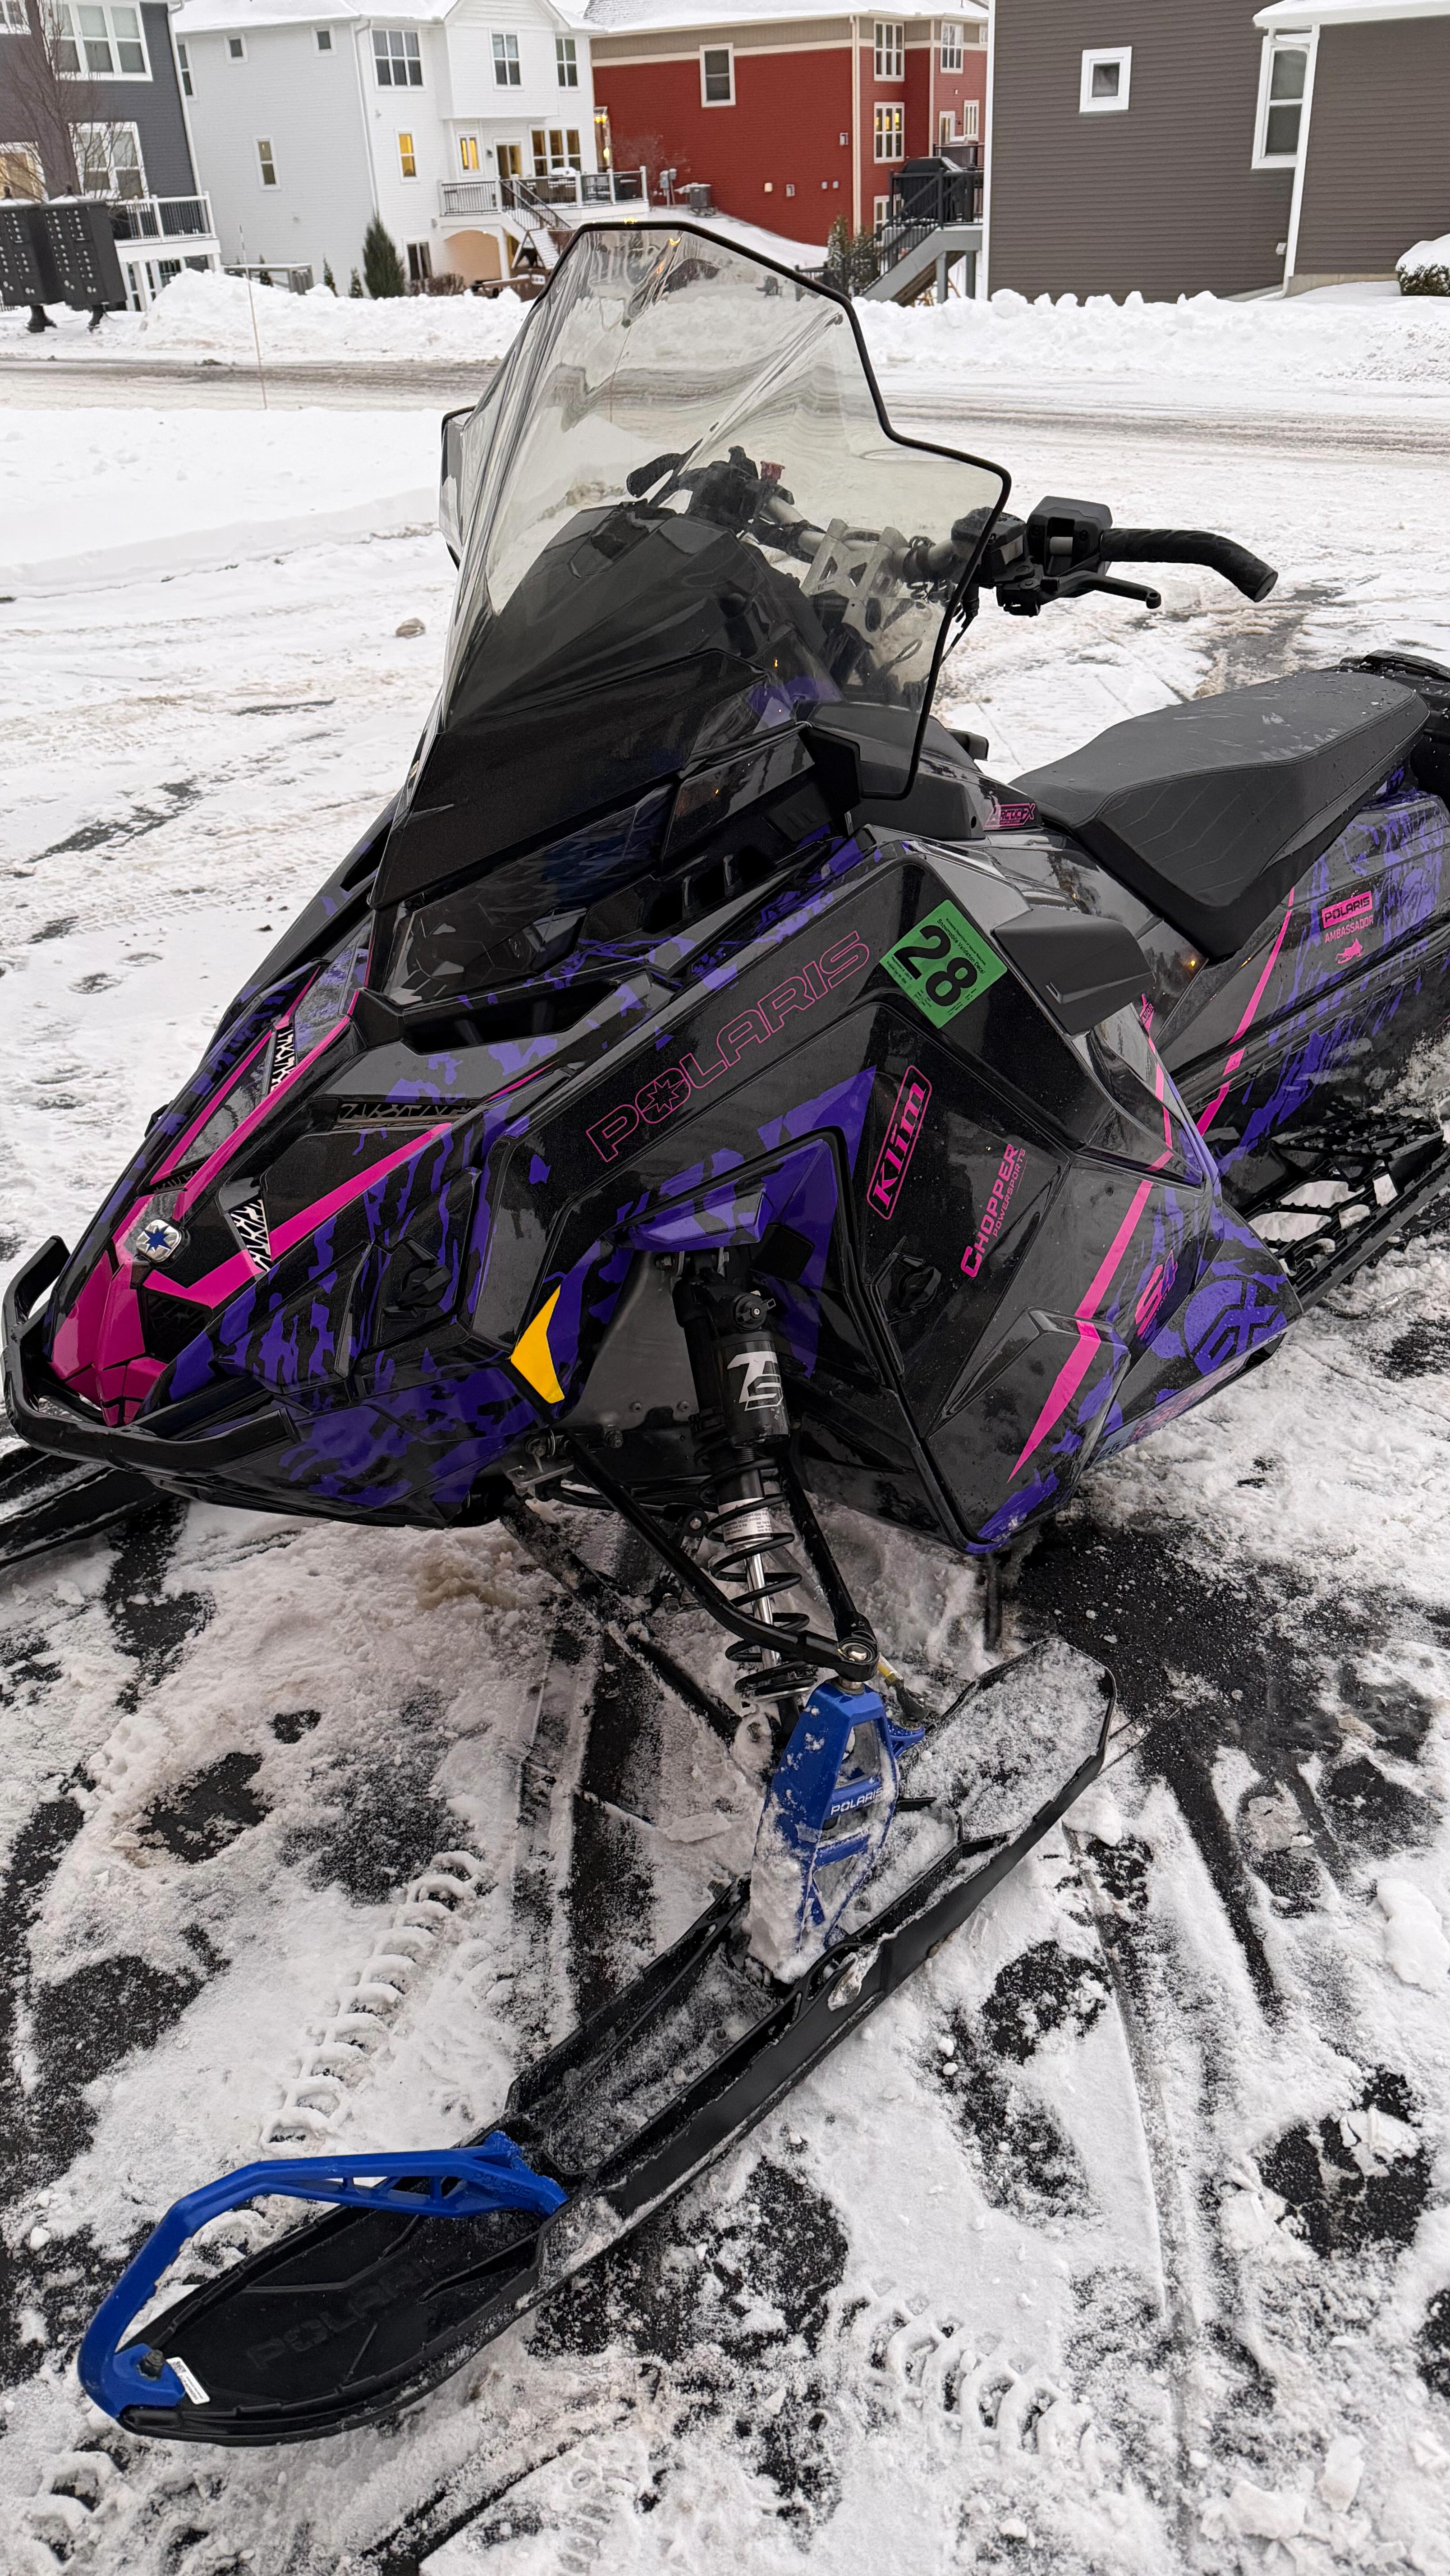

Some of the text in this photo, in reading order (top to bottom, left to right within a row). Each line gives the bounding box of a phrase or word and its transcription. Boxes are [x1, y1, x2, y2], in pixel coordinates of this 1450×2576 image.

[1325, 896, 1370, 922] POLARIS
[1325, 915, 1374, 943] AMBASSADOR
[893, 925, 977, 1007] 28
[937, 918, 986, 974] Snowmobile Validation Decal
[586, 930, 870, 1163] POLARIS
[960, 1144, 1018, 1278] CHOPPER
[993, 1149, 1026, 1237] POWERSPORTS
[831, 1787, 884, 1815] POLARIS
